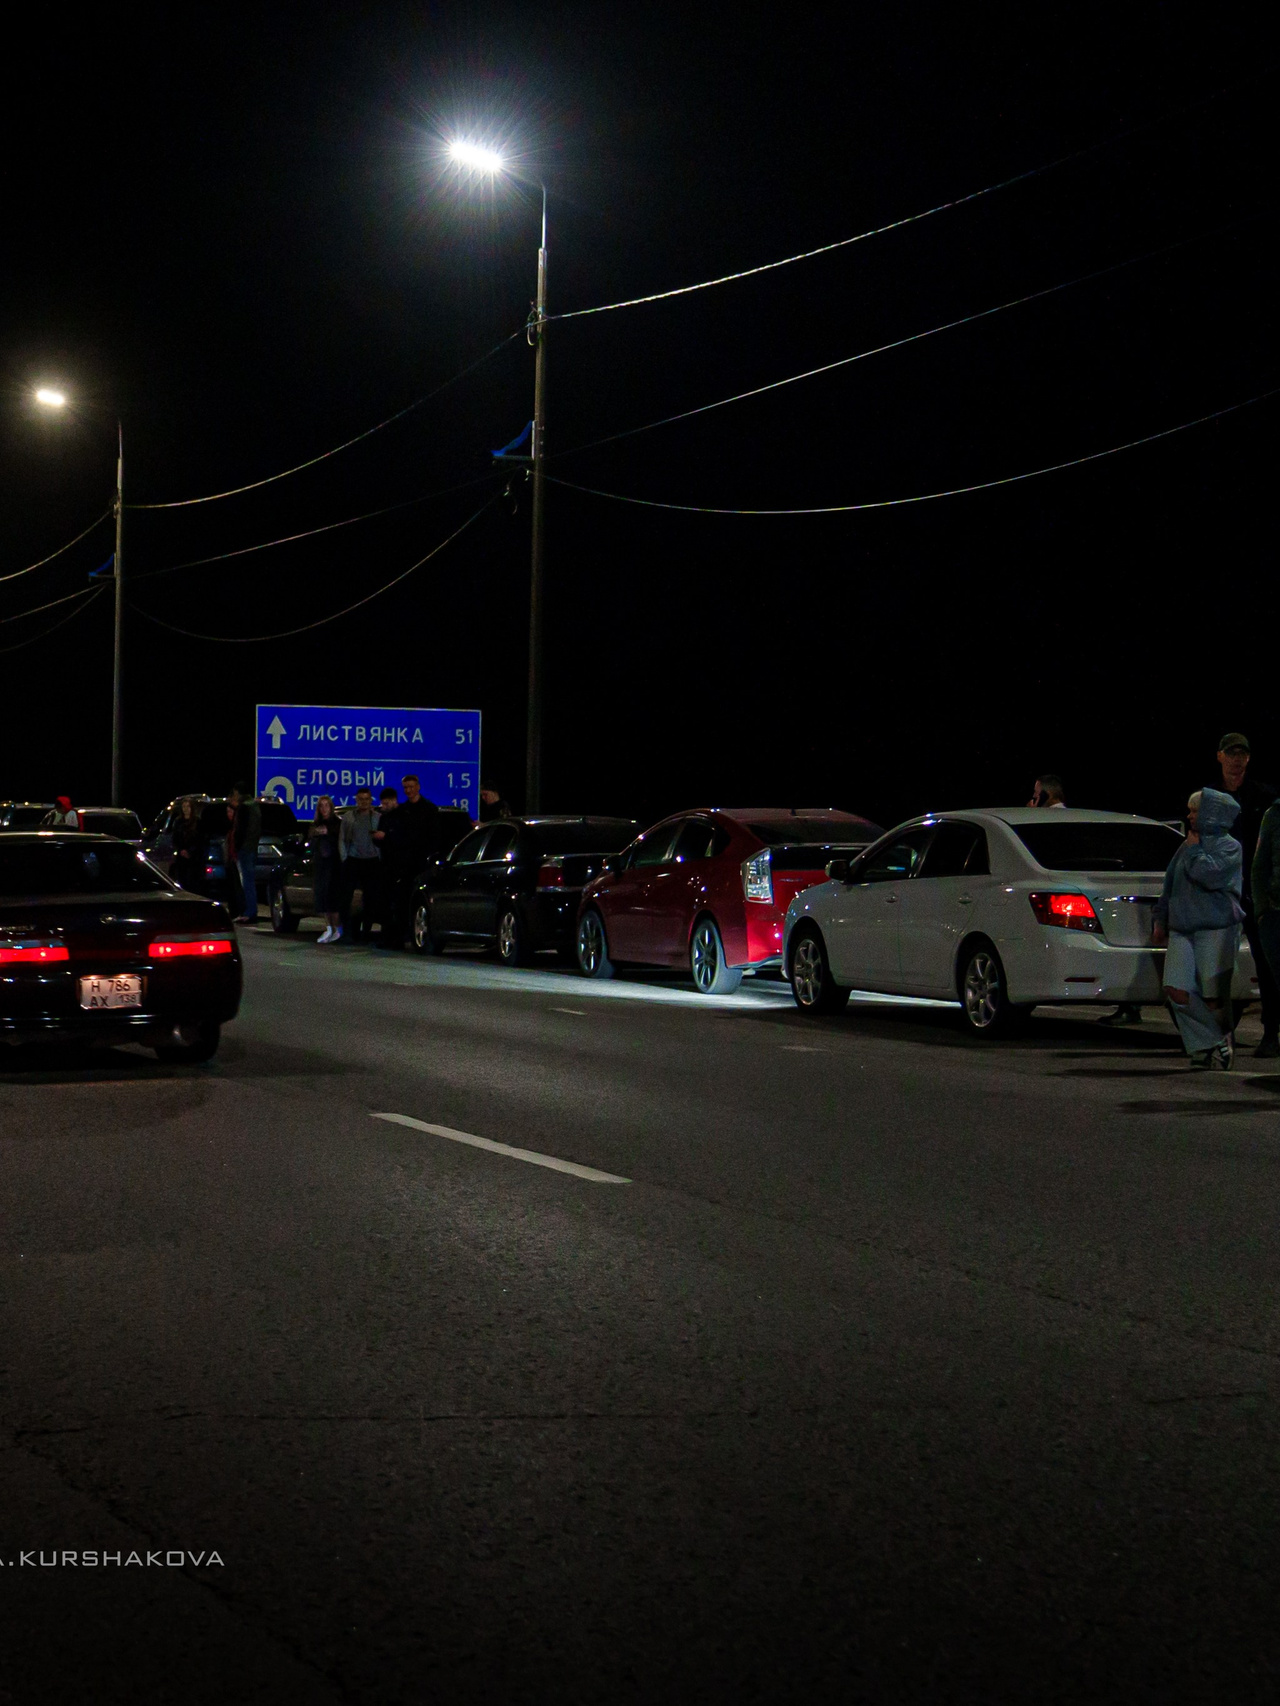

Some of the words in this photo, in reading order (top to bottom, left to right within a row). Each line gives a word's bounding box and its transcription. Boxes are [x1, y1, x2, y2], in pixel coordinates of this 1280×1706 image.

[297, 724, 424, 744] ЛИСТВЯНКА
[454, 728, 474, 745] 51
[296, 766, 385, 787] ЕЛОВЫЙ
[447, 772, 471, 789] 1.5
[451, 798, 470, 812] 18
[108, 979, 130, 993] 786
